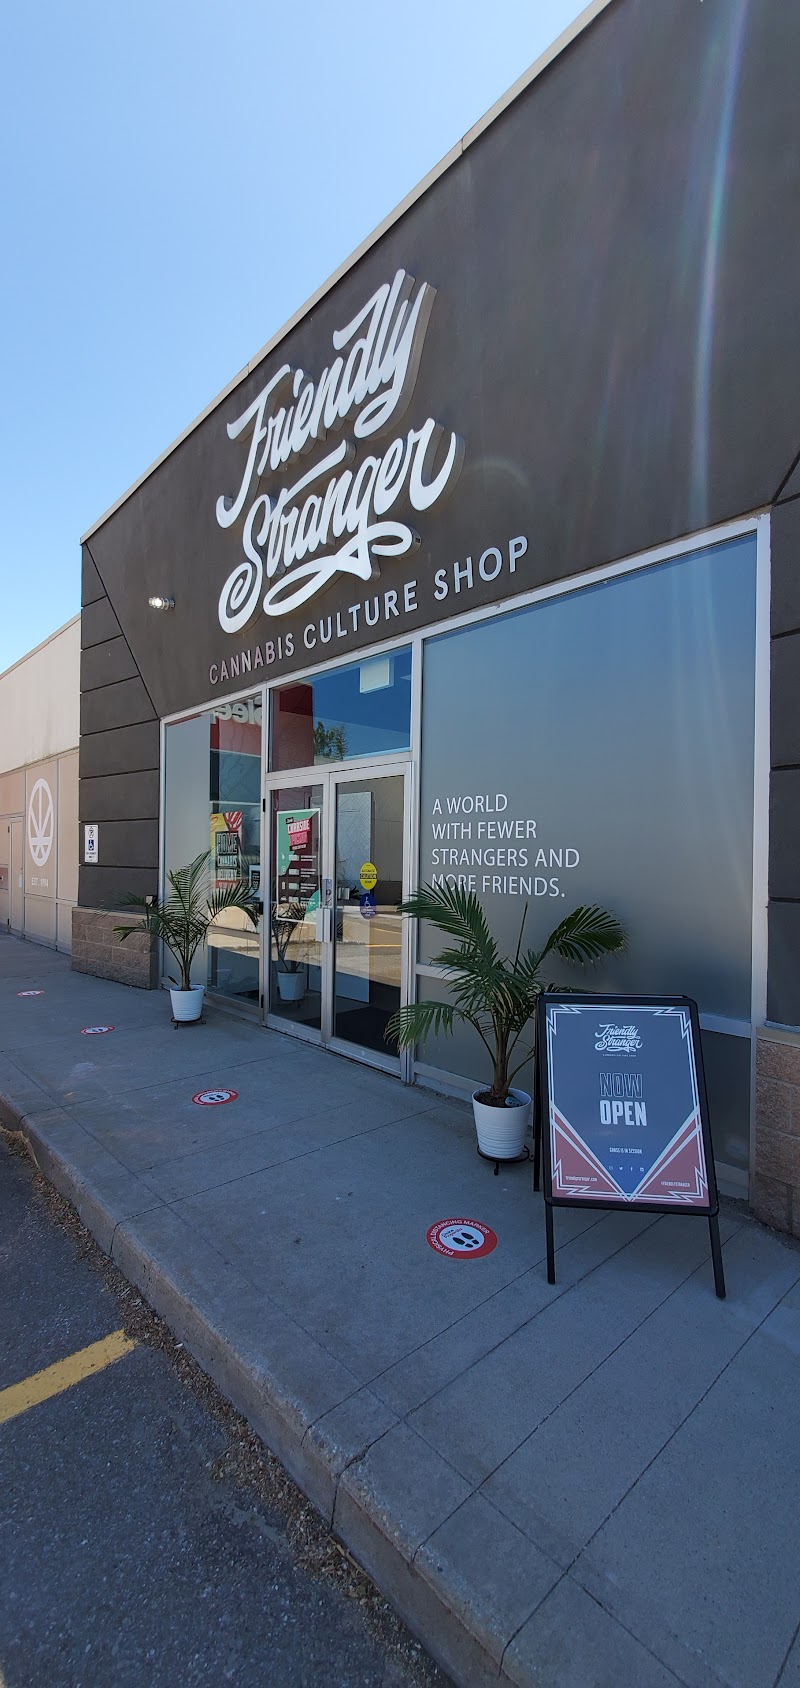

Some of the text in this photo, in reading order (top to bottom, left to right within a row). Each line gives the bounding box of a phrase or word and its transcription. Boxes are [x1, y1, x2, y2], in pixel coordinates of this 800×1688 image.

[215, 268, 431, 529] Friendly
[218, 417, 458, 634] Stranger
[208, 535, 529, 685] CANNABIS CULTURE SHOP
[432, 793, 508, 815] A WORLD
[431, 819, 537, 840] WITH FEWER
[216, 832, 238, 854] HOME
[431, 847, 580, 868] STRANGERS AND
[432, 873, 566, 898] MORE FRIENDS.
[594, 1023, 642, 1040] Friendly
[594, 1034, 643, 1053] Stranger
[600, 1072, 643, 1099] NOW
[600, 1099, 648, 1127] OPEN
[463, 1220, 490, 1234] MARKER
